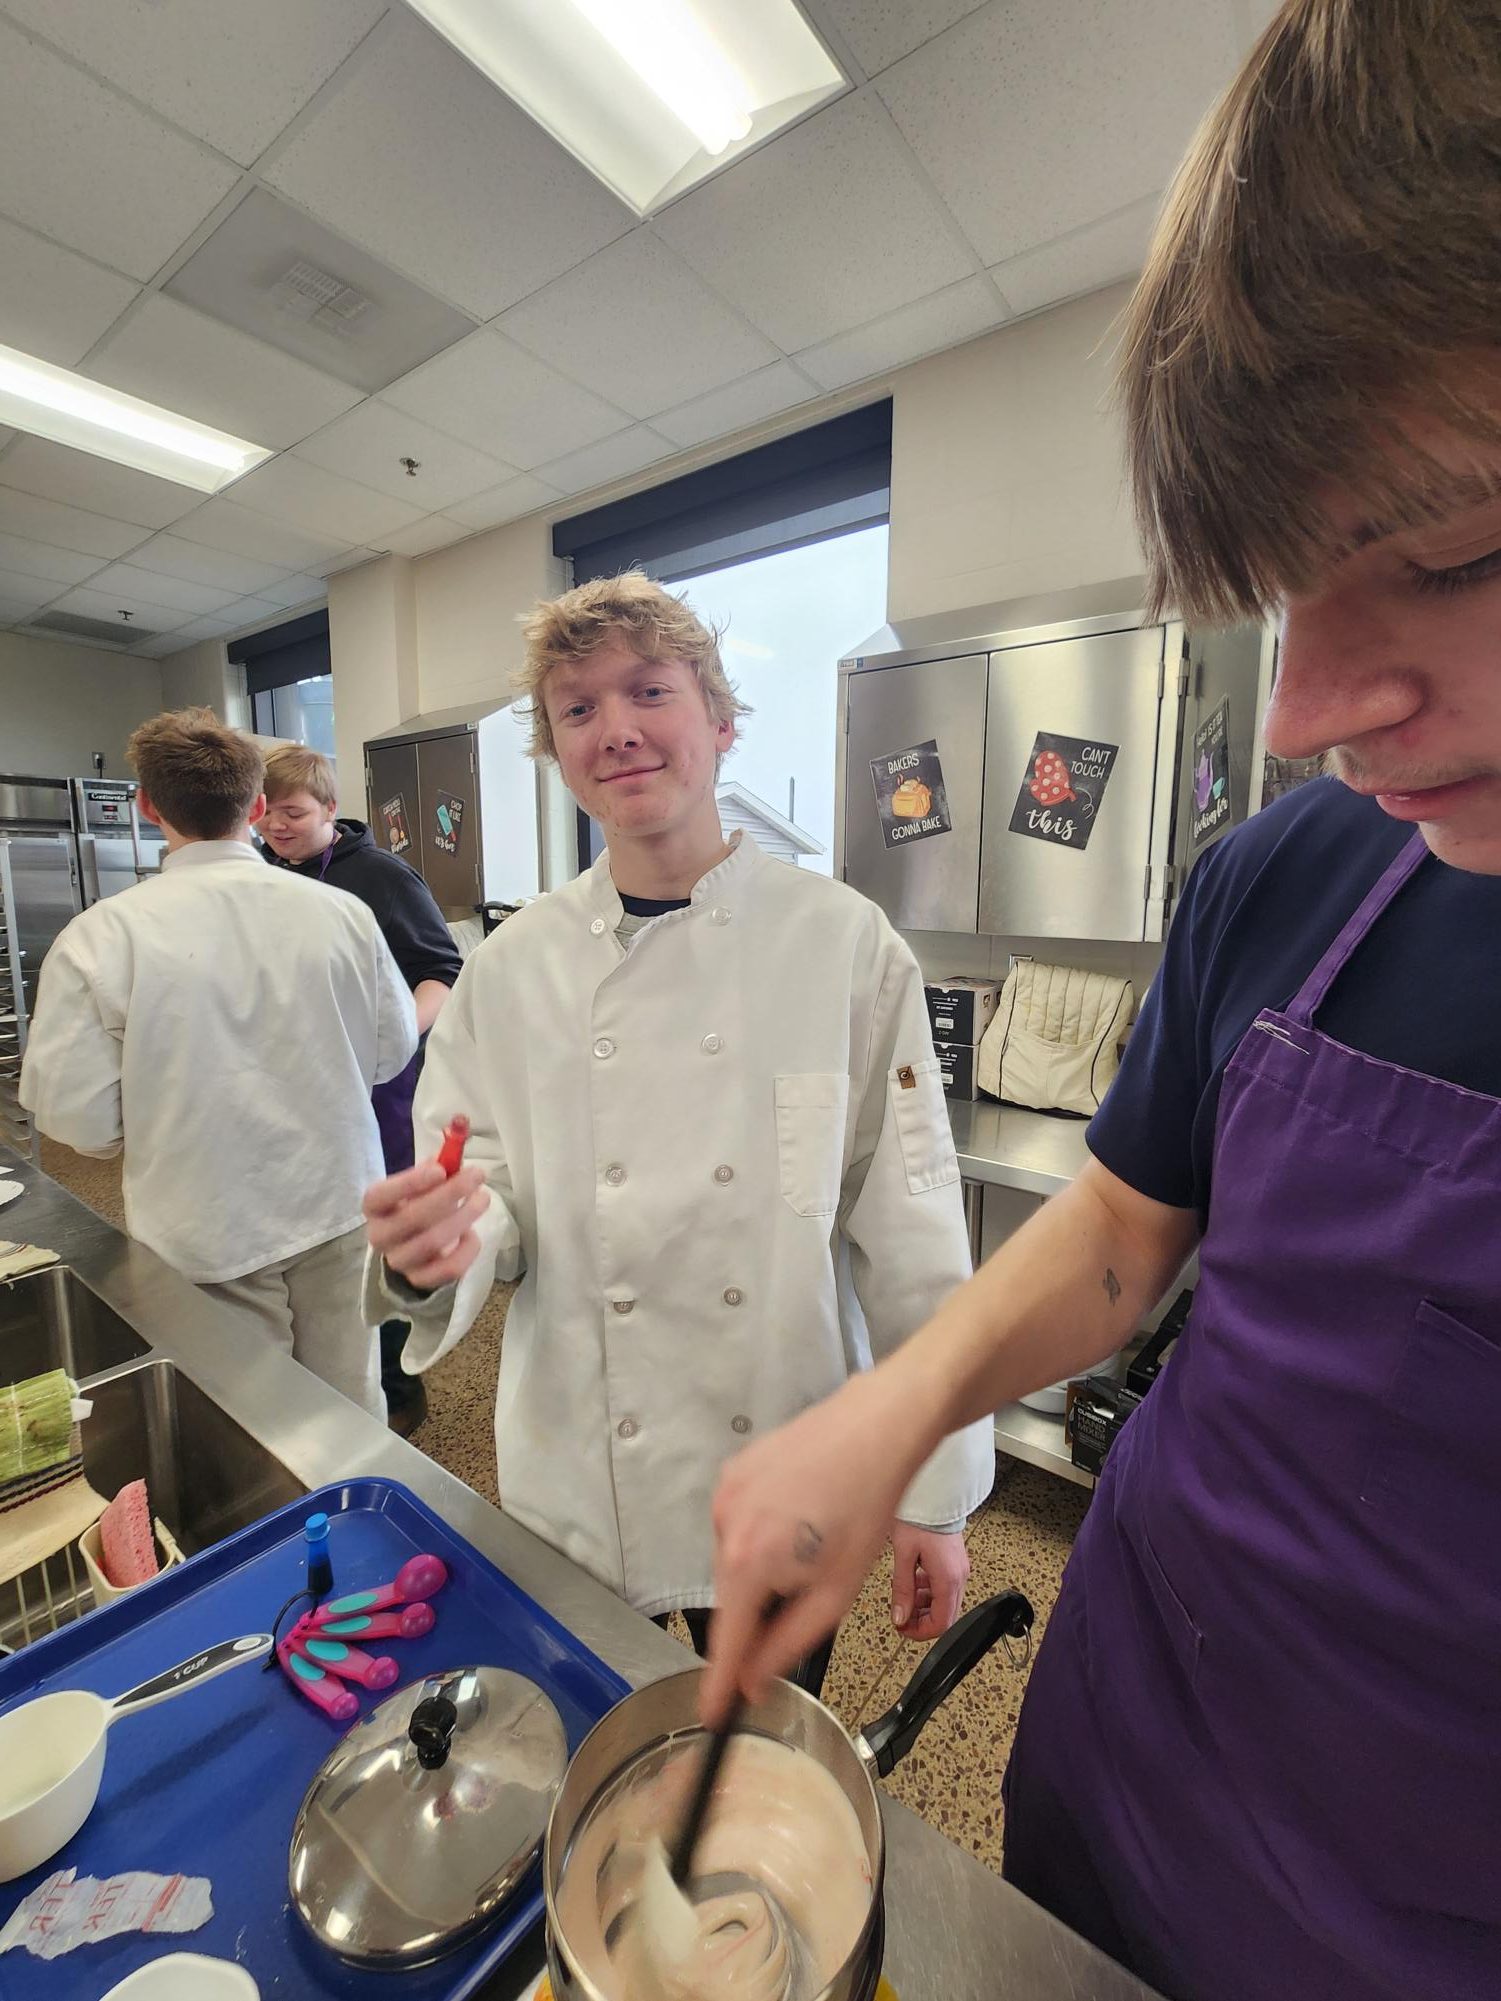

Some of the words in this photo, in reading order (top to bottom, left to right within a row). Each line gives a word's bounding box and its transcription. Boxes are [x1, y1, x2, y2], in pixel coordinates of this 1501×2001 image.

[887, 753, 920, 774] BAKERS
[1081, 746, 1111, 765] CAN'T
[1070, 760, 1105, 779] TOUCH
[892, 821, 921, 841] GONNA
[921, 815, 942, 832] BAKE
[1025, 808, 1077, 841] this
[1193, 809, 1217, 839] looking
[173, 1671, 181, 1680] 1
[183, 1656, 209, 1676] CUP
